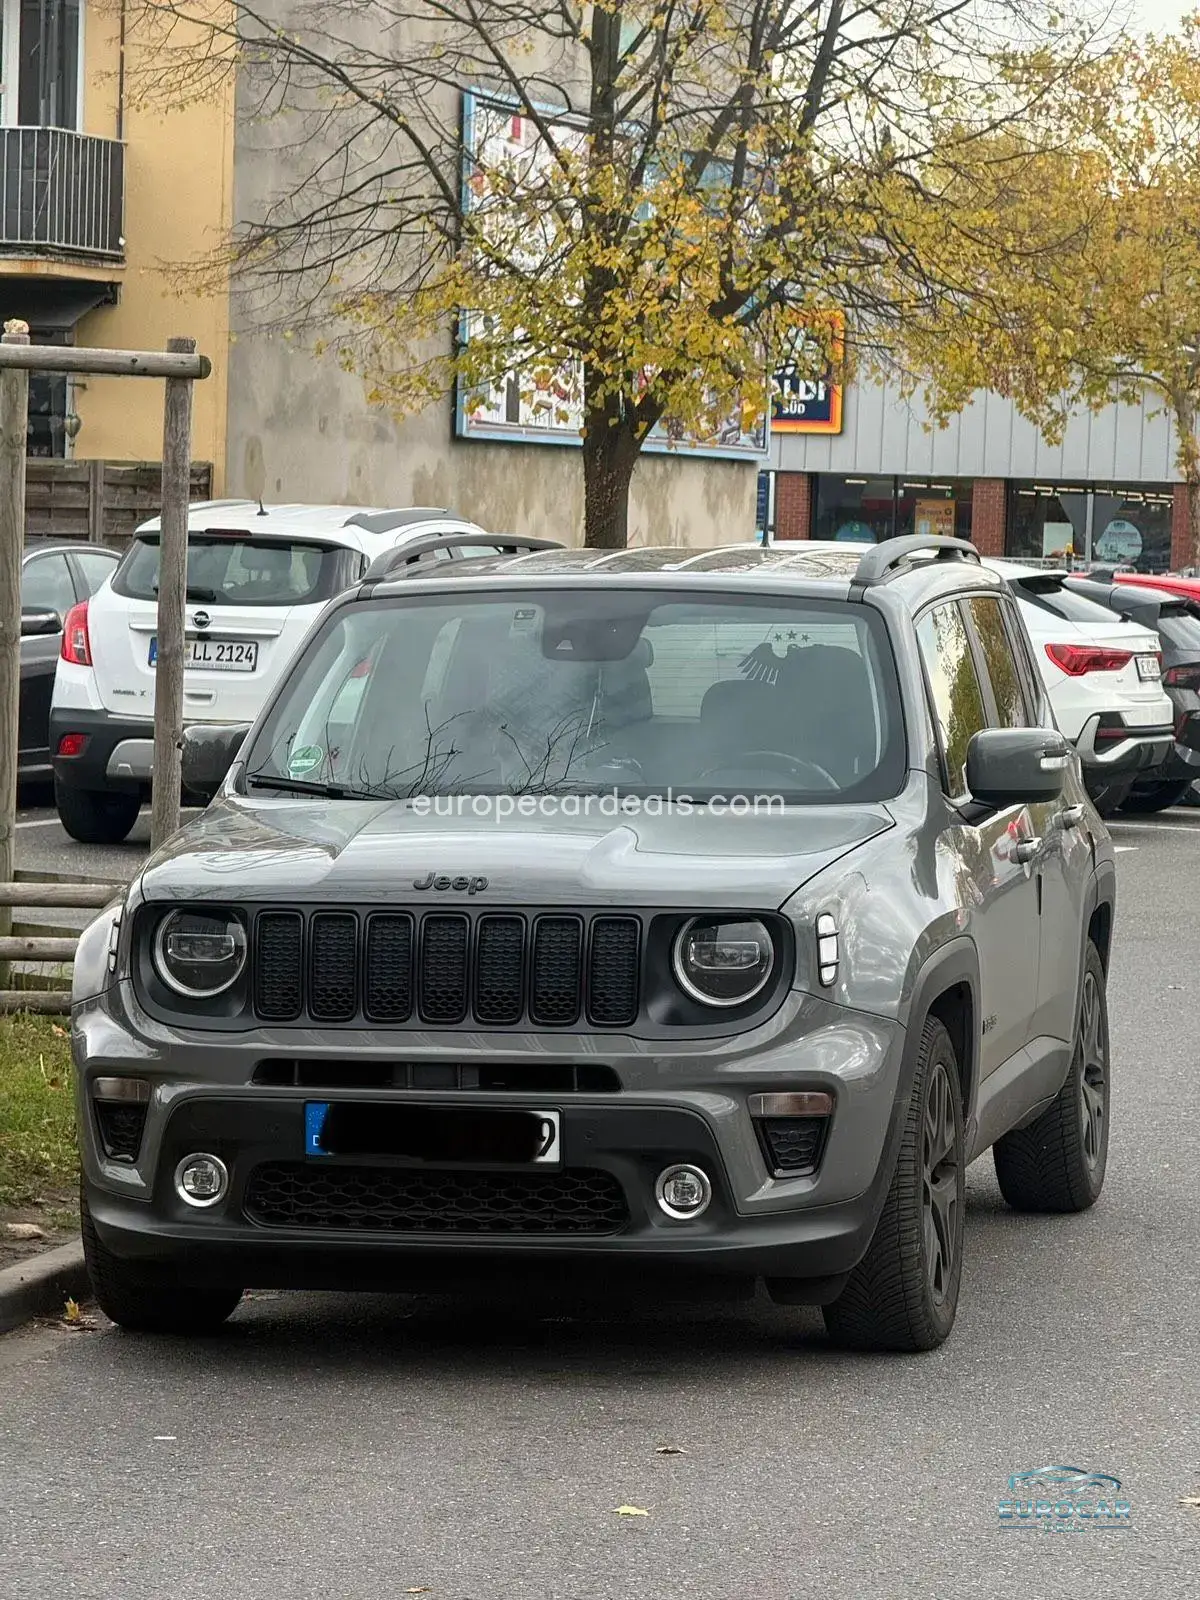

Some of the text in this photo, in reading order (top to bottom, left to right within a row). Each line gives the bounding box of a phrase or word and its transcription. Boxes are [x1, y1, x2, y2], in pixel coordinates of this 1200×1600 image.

[192, 643, 254, 663] LL 2124
[413, 872, 489, 896] Jeep
